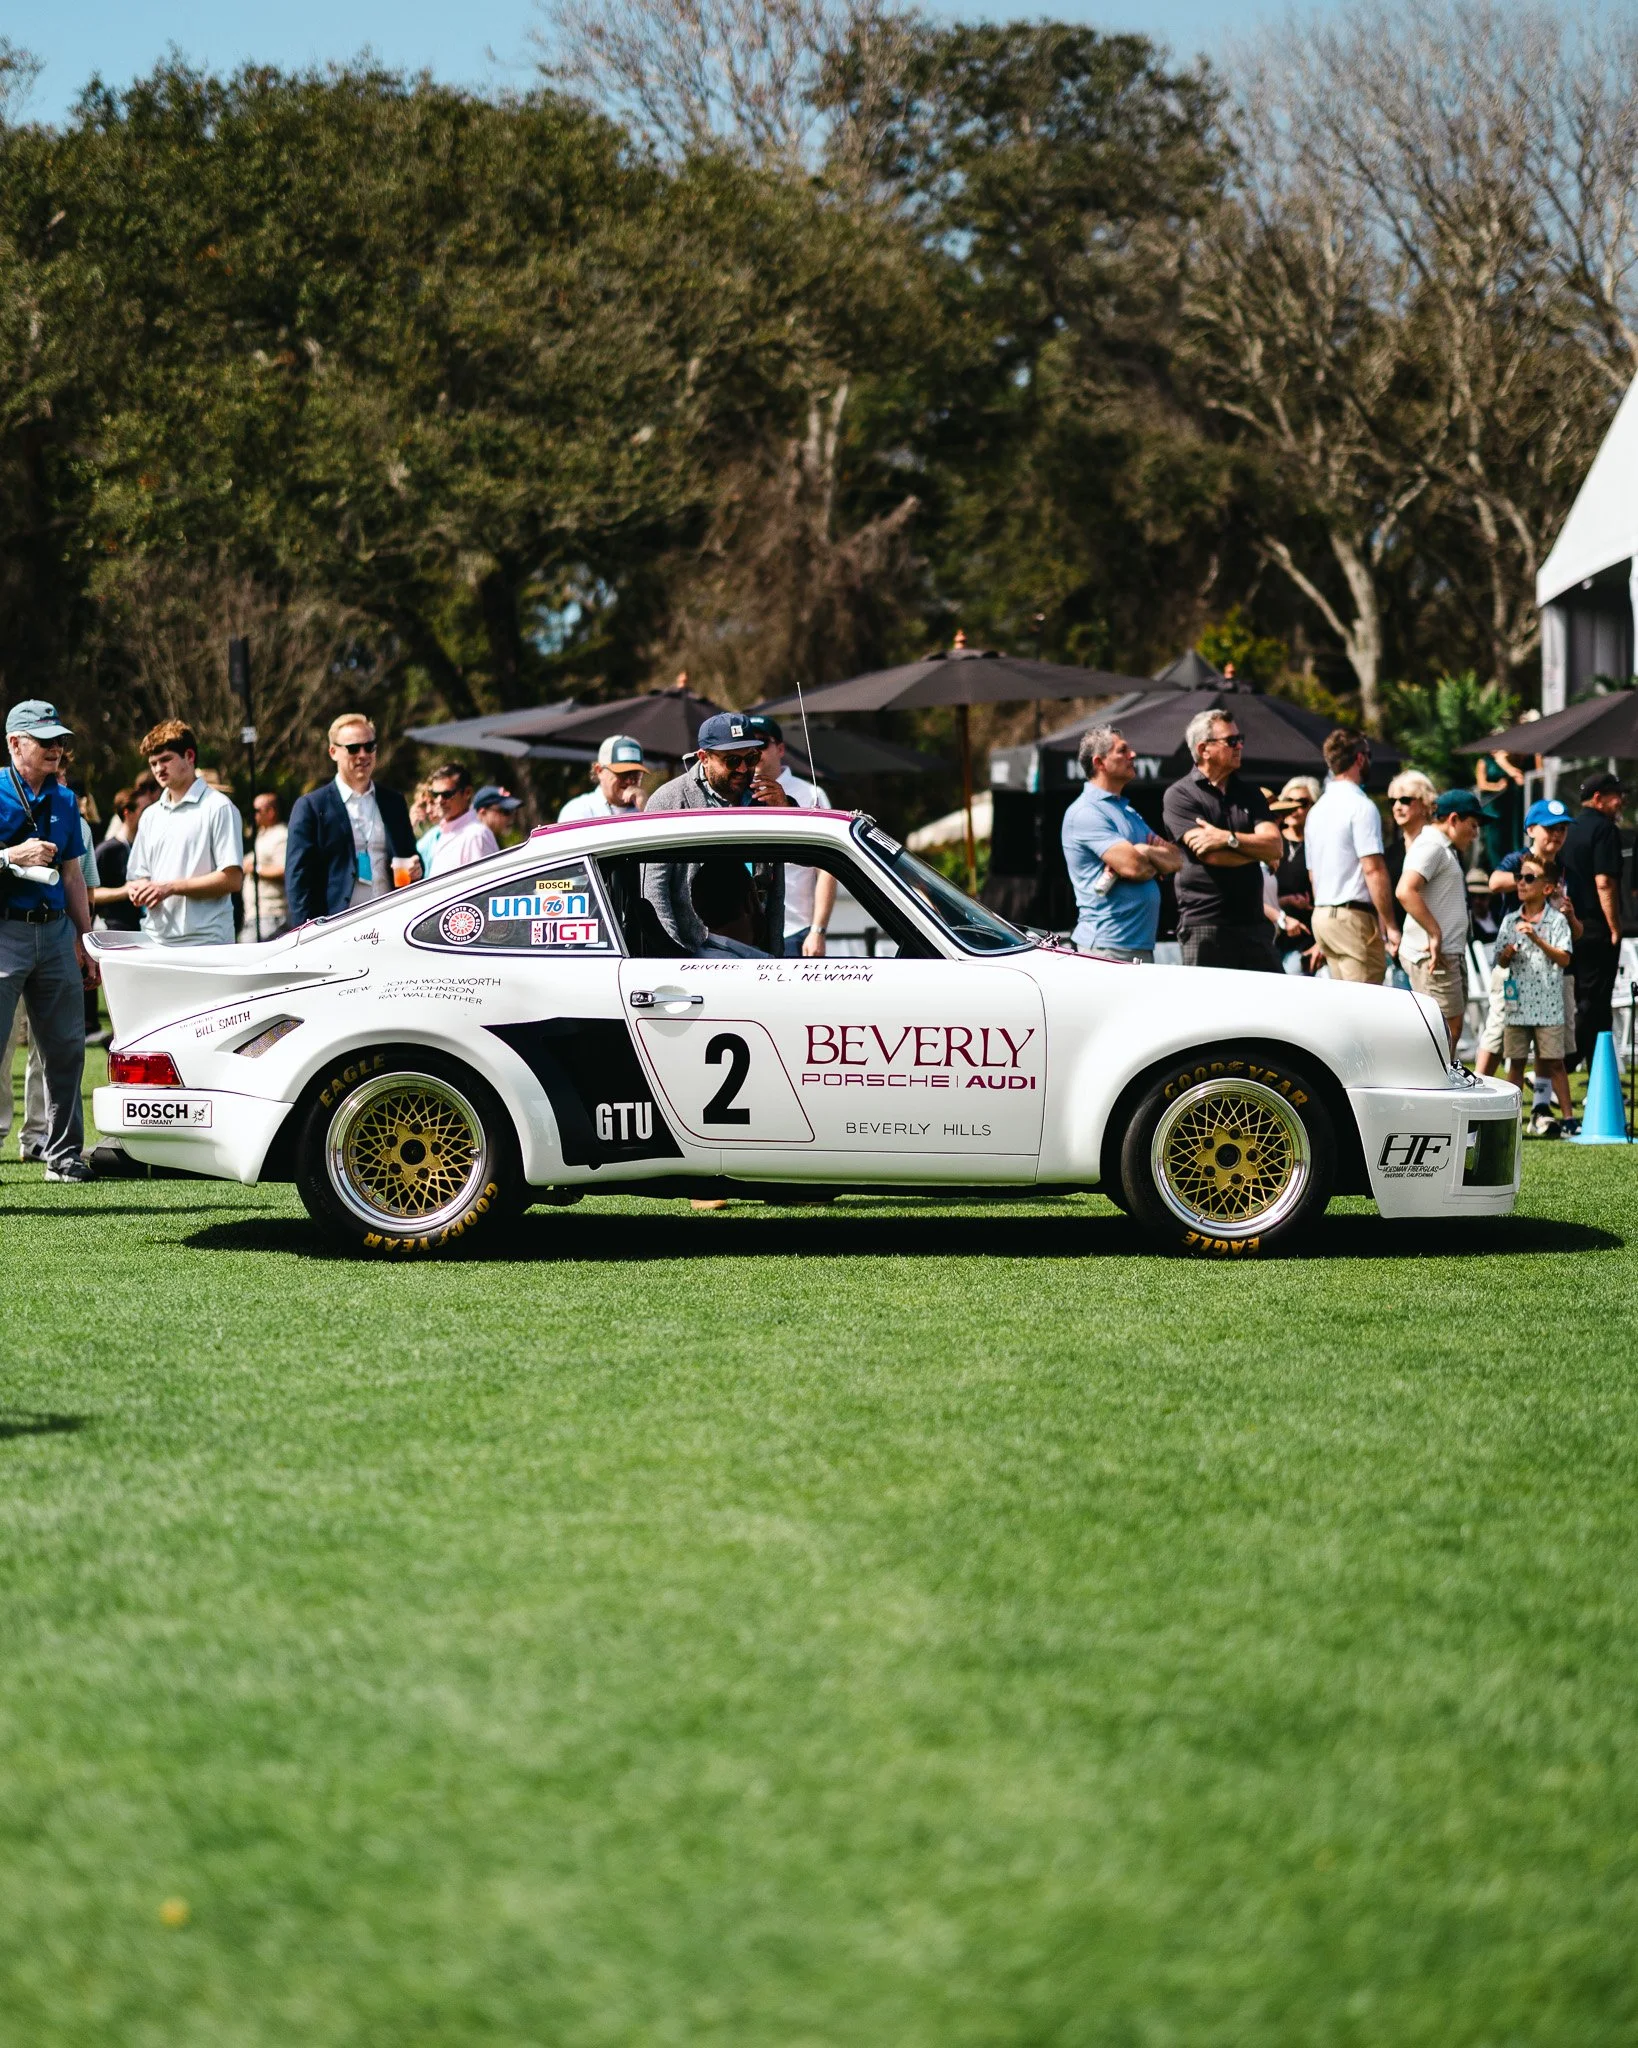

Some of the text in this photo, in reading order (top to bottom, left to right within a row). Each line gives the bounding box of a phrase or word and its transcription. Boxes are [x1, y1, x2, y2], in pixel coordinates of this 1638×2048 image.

[538, 881, 570, 890] BOSCH
[446, 907, 467, 920] SPORTS
[468, 908, 478, 918] CAR
[545, 901, 563, 913] 76
[446, 932, 471, 941] AMERICA
[559, 923, 597, 941] GT
[383, 978, 418, 987] JOHN
[422, 977, 501, 987] WOOLWORTH
[801, 973, 874, 982] NEWMAN
[413, 985, 475, 994] JOHNSON
[378, 992, 483, 1005] RAY WALLENTHER
[195, 1024, 216, 1038] BILL
[219, 1010, 251, 1030] SMITH
[804, 1024, 1036, 1069] BEVERLY
[319, 1053, 386, 1108] EAGLE
[703, 1032, 751, 1125] 2
[801, 1073, 1036, 1090] PORSCHE AUDI
[126, 1102, 189, 1119] BOSCH
[595, 1101, 653, 1141] GTU
[846, 1122, 992, 1137] BEVERLY HILLS
[1379, 1134, 1452, 1166] HF
[1180, 1230, 1261, 1255] EAGLE
